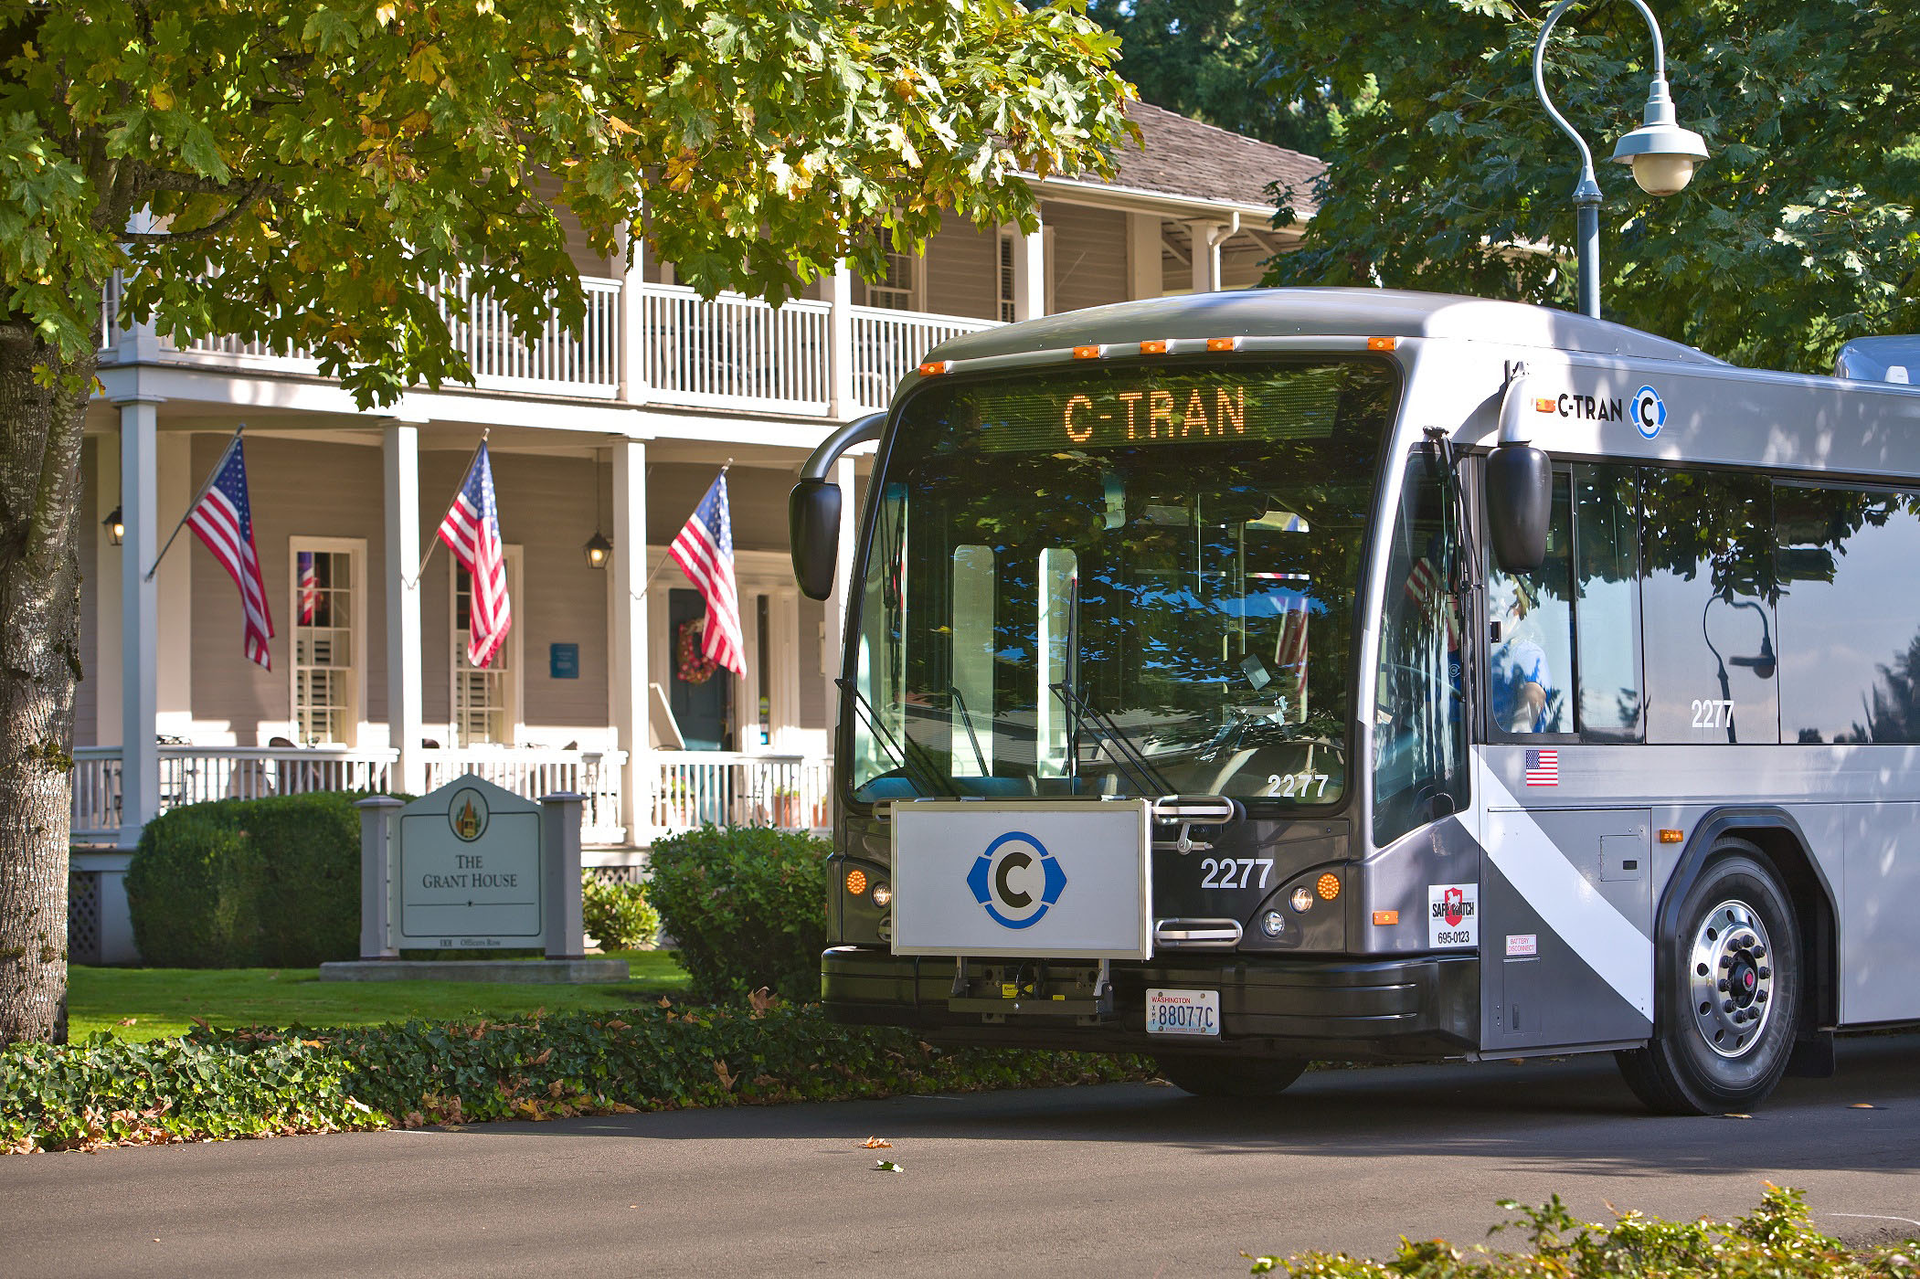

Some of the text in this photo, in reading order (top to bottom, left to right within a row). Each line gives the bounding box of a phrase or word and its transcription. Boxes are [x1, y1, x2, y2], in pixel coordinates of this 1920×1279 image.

[1064, 386, 1244, 442] C-TRAN
[1557, 393, 1623, 423] C-TRAN
[1640, 396, 1655, 428] C
[1691, 699, 1735, 728] 2277
[1267, 774, 1329, 798] 2277
[455, 854, 483, 869] THE
[422, 873, 518, 889] GRANT HOUSE
[995, 851, 1033, 908] C
[1200, 858, 1274, 889] 2277
[1437, 930, 1470, 944] 695-0123
[1508, 944, 1535, 952] DISCONNECT
[1510, 937, 1530, 945] BATTERY
[1151, 996, 1191, 1004] WASHINGTON
[1159, 1005, 1214, 1028] 88077C
